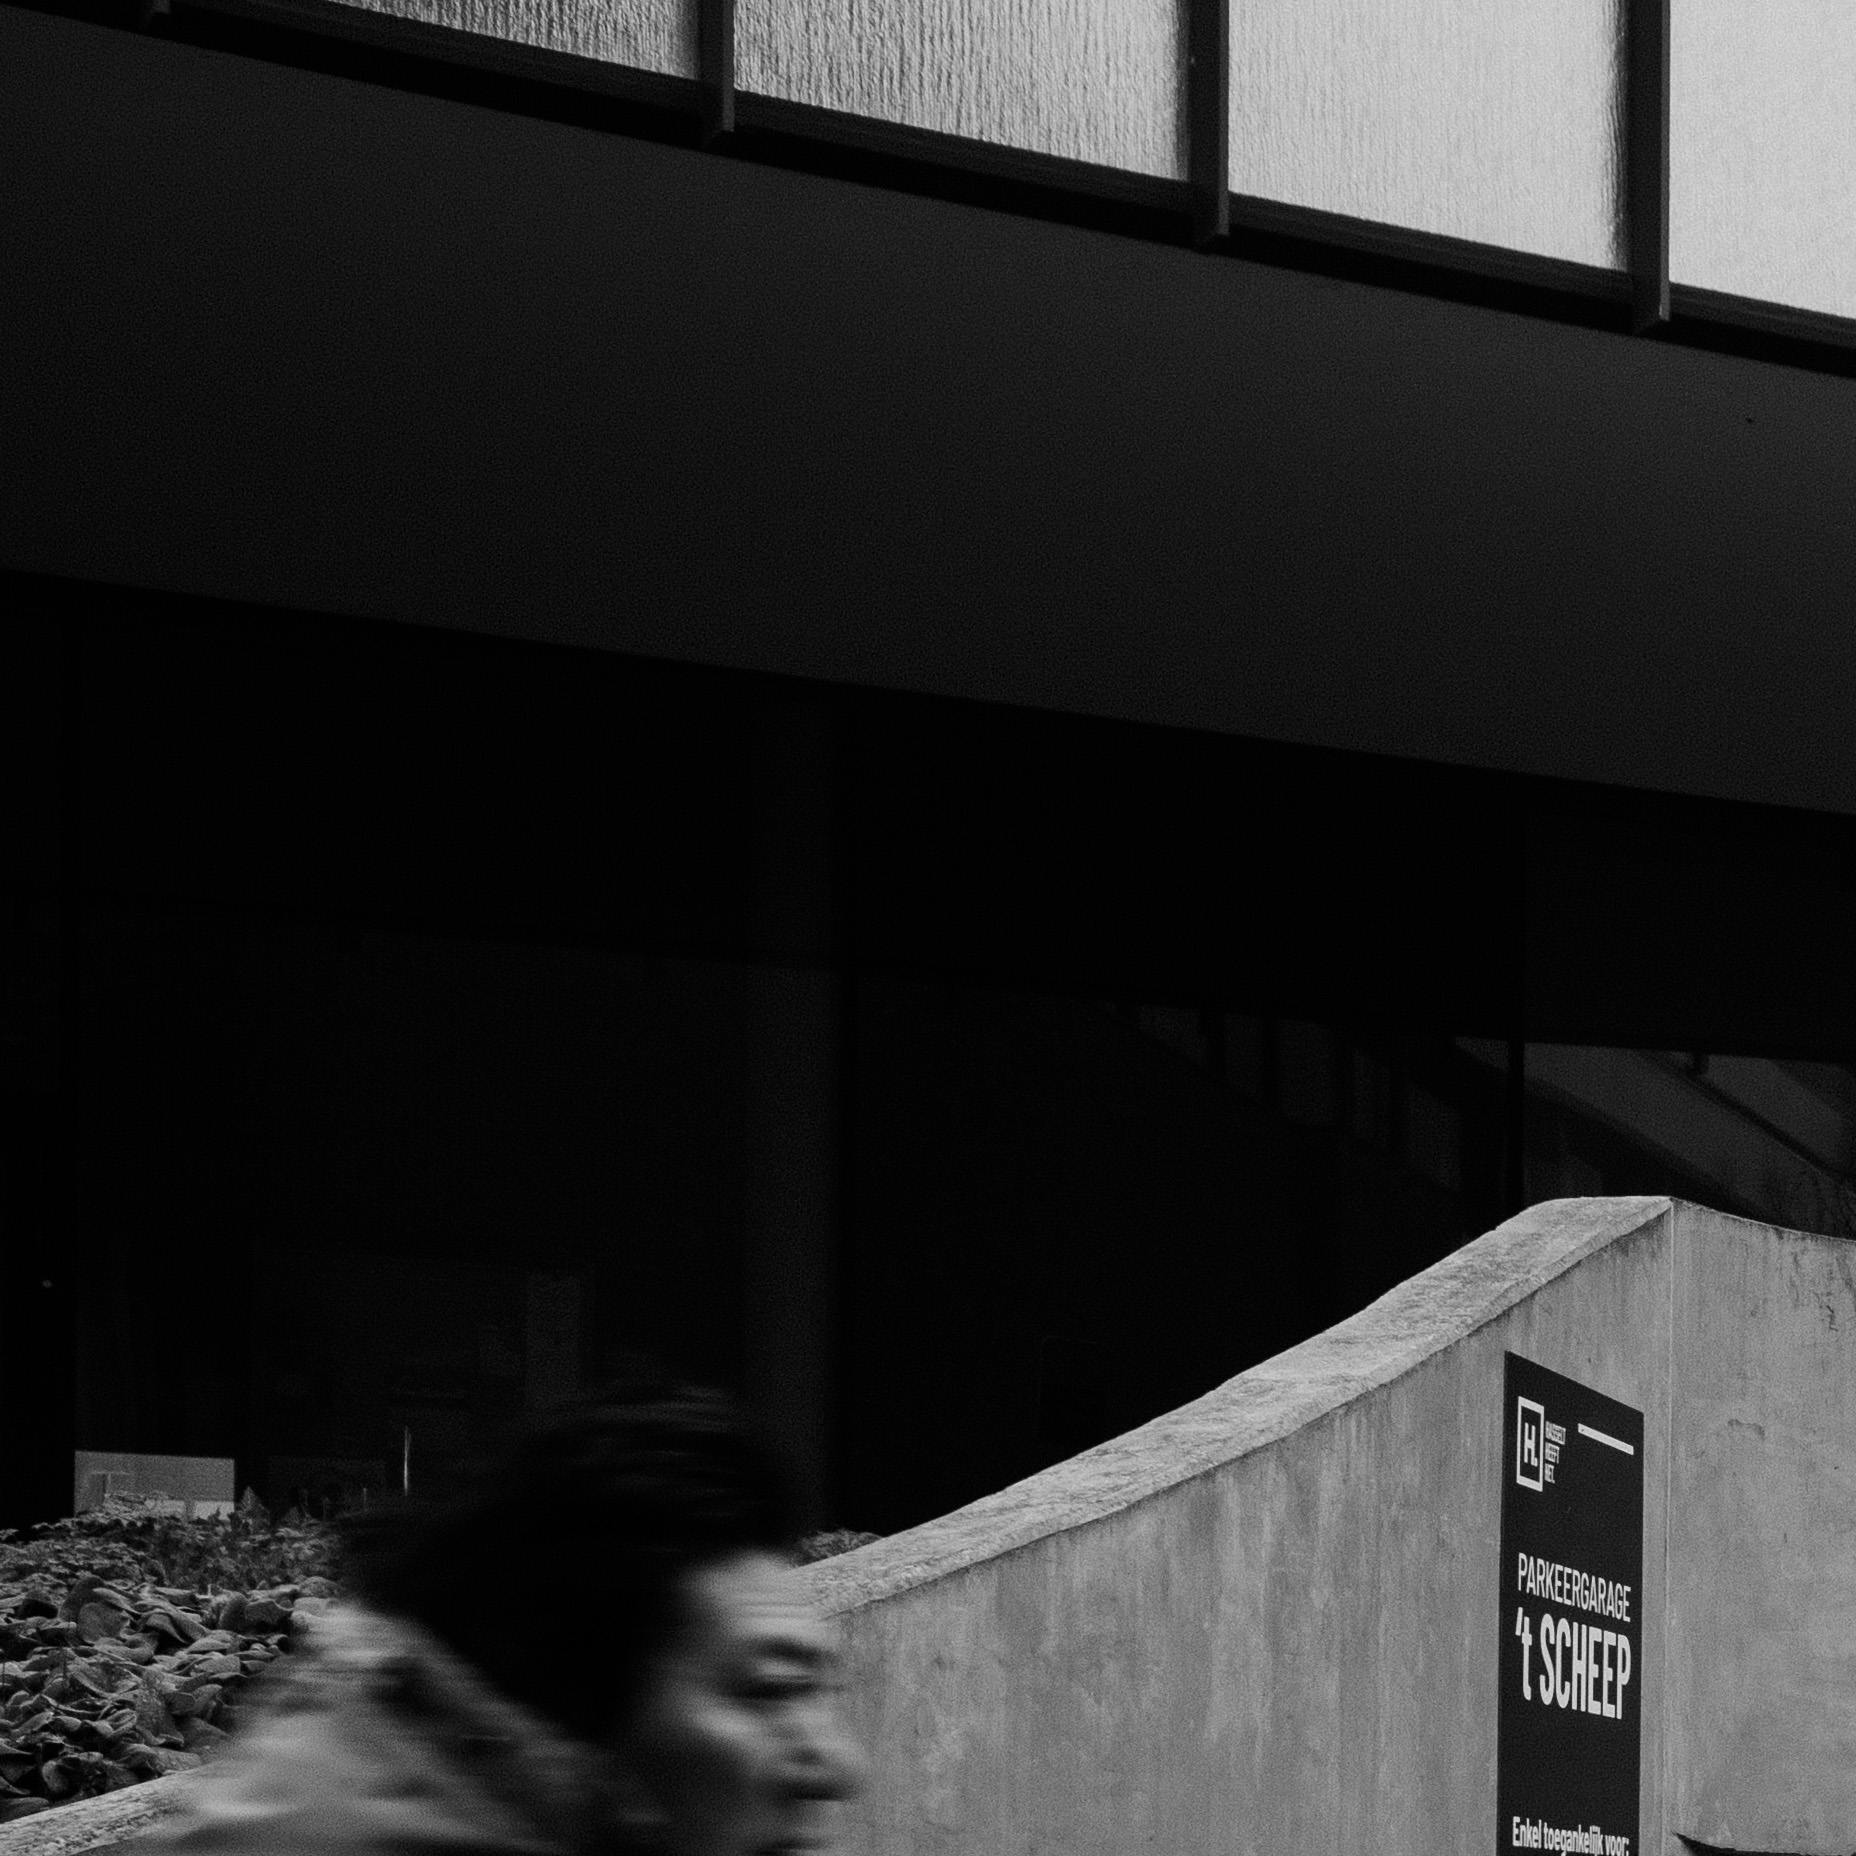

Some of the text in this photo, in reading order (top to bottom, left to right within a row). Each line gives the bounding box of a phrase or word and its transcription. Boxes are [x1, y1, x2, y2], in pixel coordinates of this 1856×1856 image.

[1518, 1553, 1631, 1622] PARKEERGARAGE
[1539, 1613, 1631, 1720] SCHEEP
[1512, 1816, 1541, 1849] Enkel
